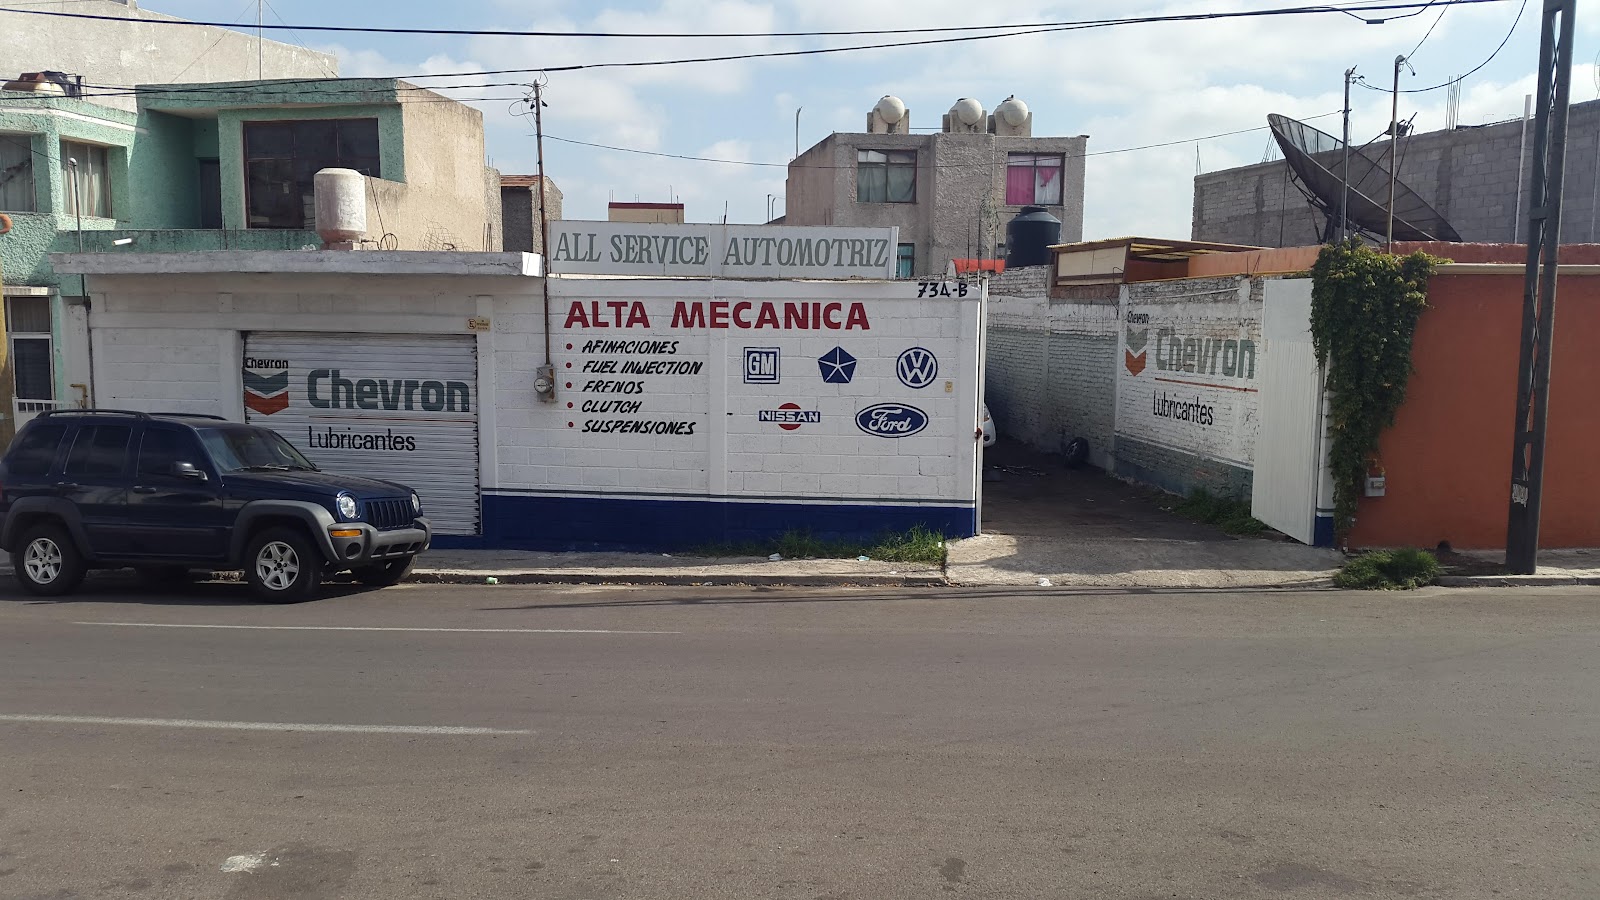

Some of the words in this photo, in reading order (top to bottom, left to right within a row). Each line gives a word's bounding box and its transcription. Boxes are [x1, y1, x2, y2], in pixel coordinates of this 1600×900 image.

[553, 232, 602, 262] ALL
[610, 234, 709, 265] SERVICE
[724, 237, 889, 267] AUTOMOTRIZ
[563, 301, 650, 328] ALTA
[670, 301, 870, 330] MECANICA
[1127, 310, 1149, 324] Chevron
[582, 340, 679, 354] AFINACIONES
[1155, 326, 1256, 379] Chevron
[245, 357, 289, 369] Chevron
[582, 360, 618, 374] FUEL
[620, 360, 703, 375] INJECTION
[748, 353, 775, 375] GM
[307, 369, 470, 412] Chevron
[581, 400, 642, 413] CLUTCH
[760, 410, 819, 422] NISSAN
[1153, 390, 1213, 425] Lubricantes
[581, 419, 697, 435] SUSPENSIONES
[868, 408, 912, 431] Ford
[308, 425, 416, 451] Lubricantes
